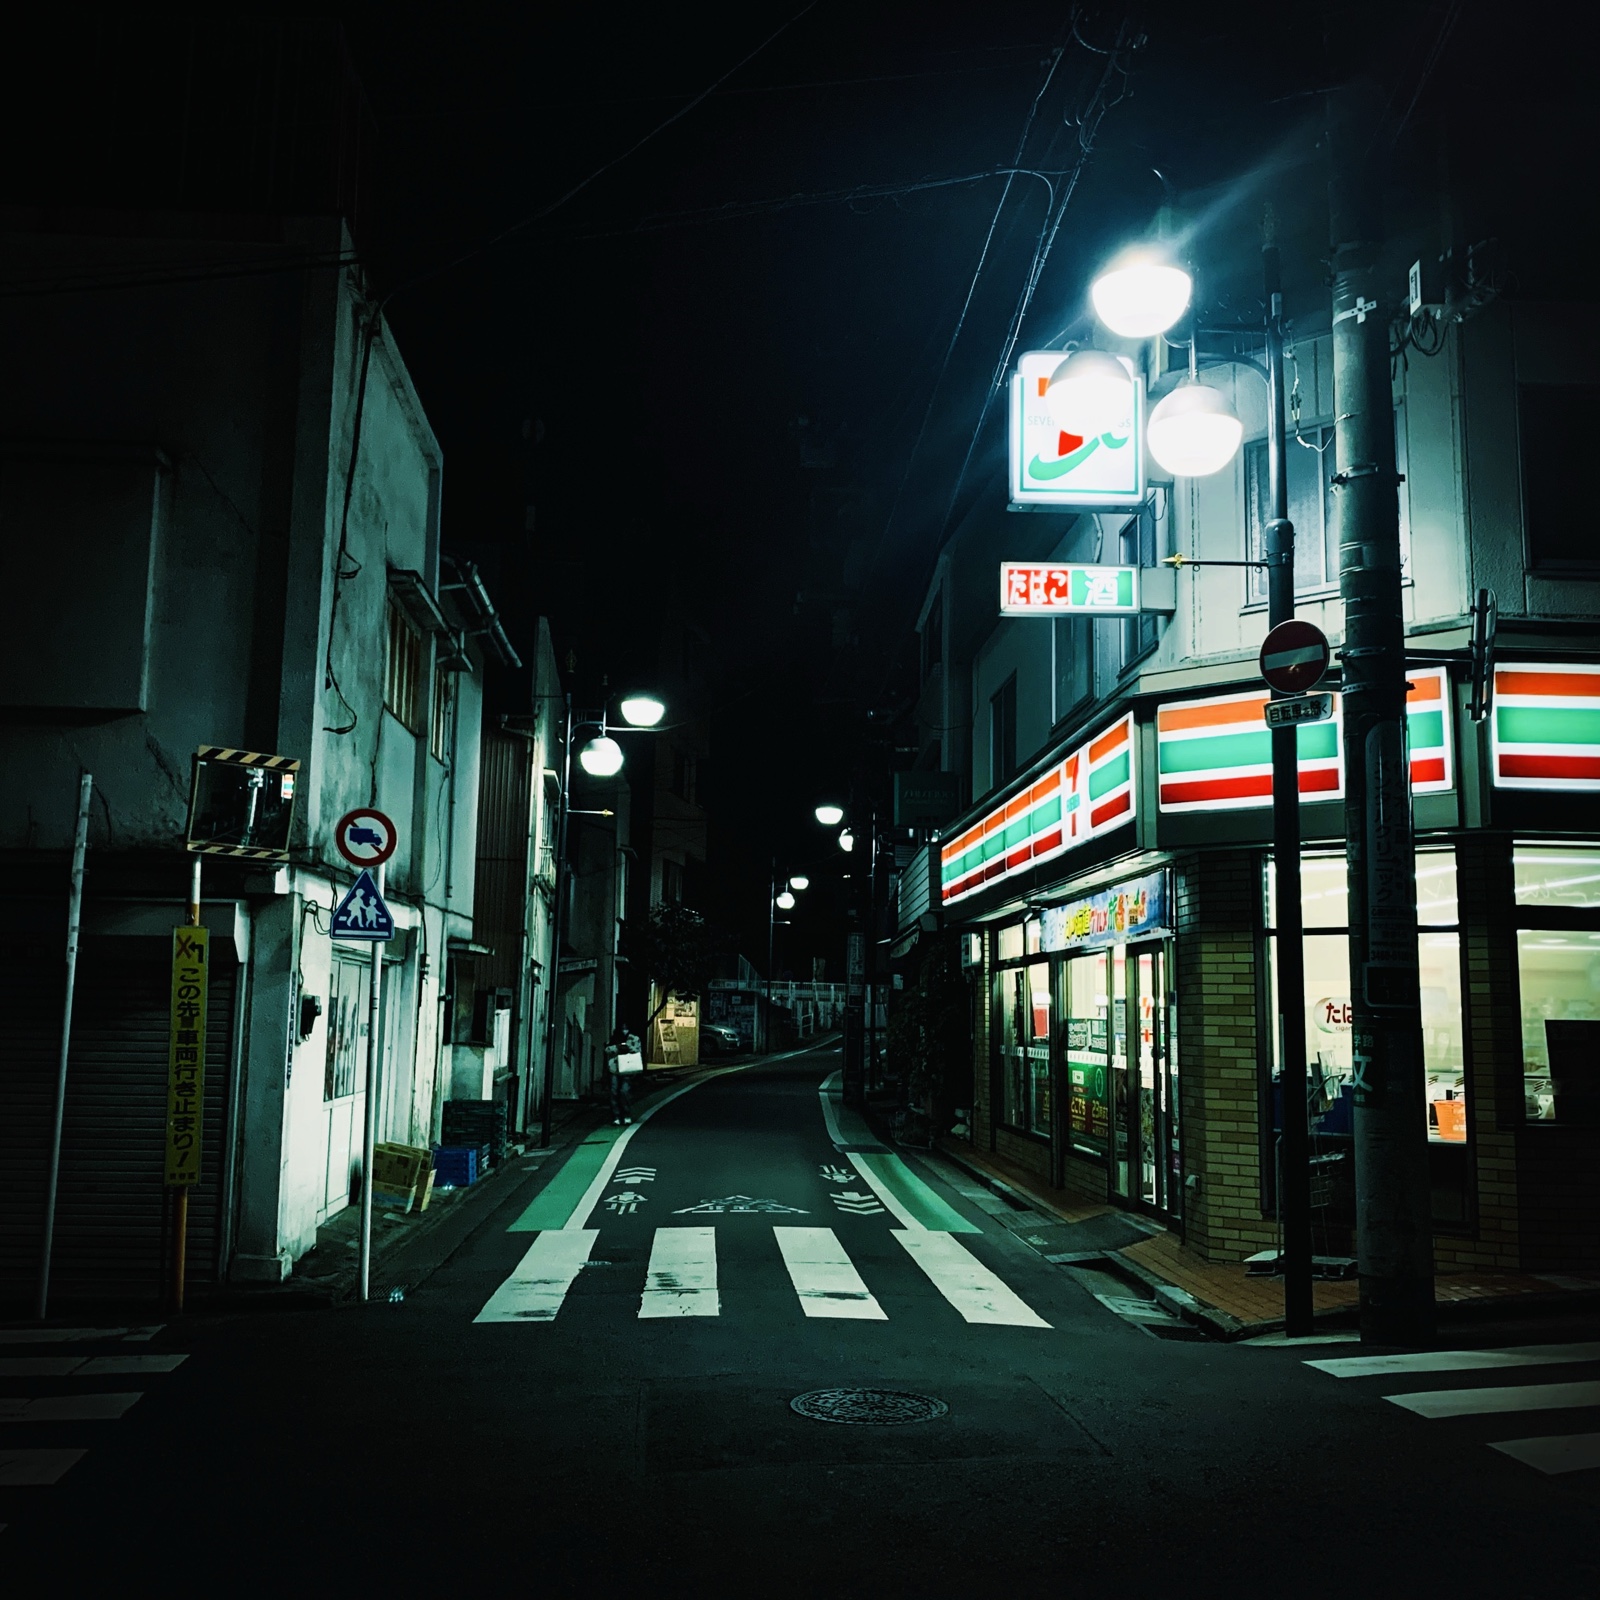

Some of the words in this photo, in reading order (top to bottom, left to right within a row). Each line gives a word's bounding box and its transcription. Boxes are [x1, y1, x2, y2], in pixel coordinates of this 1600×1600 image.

[1028, 416, 1055, 426] SEVE
[1009, 570, 1068, 605] たばこ
[1084, 570, 1120, 606] 酒
[1270, 700, 1328, 723] 自転車を除く
[1375, 760, 1394, 903] メンタルクリニック
